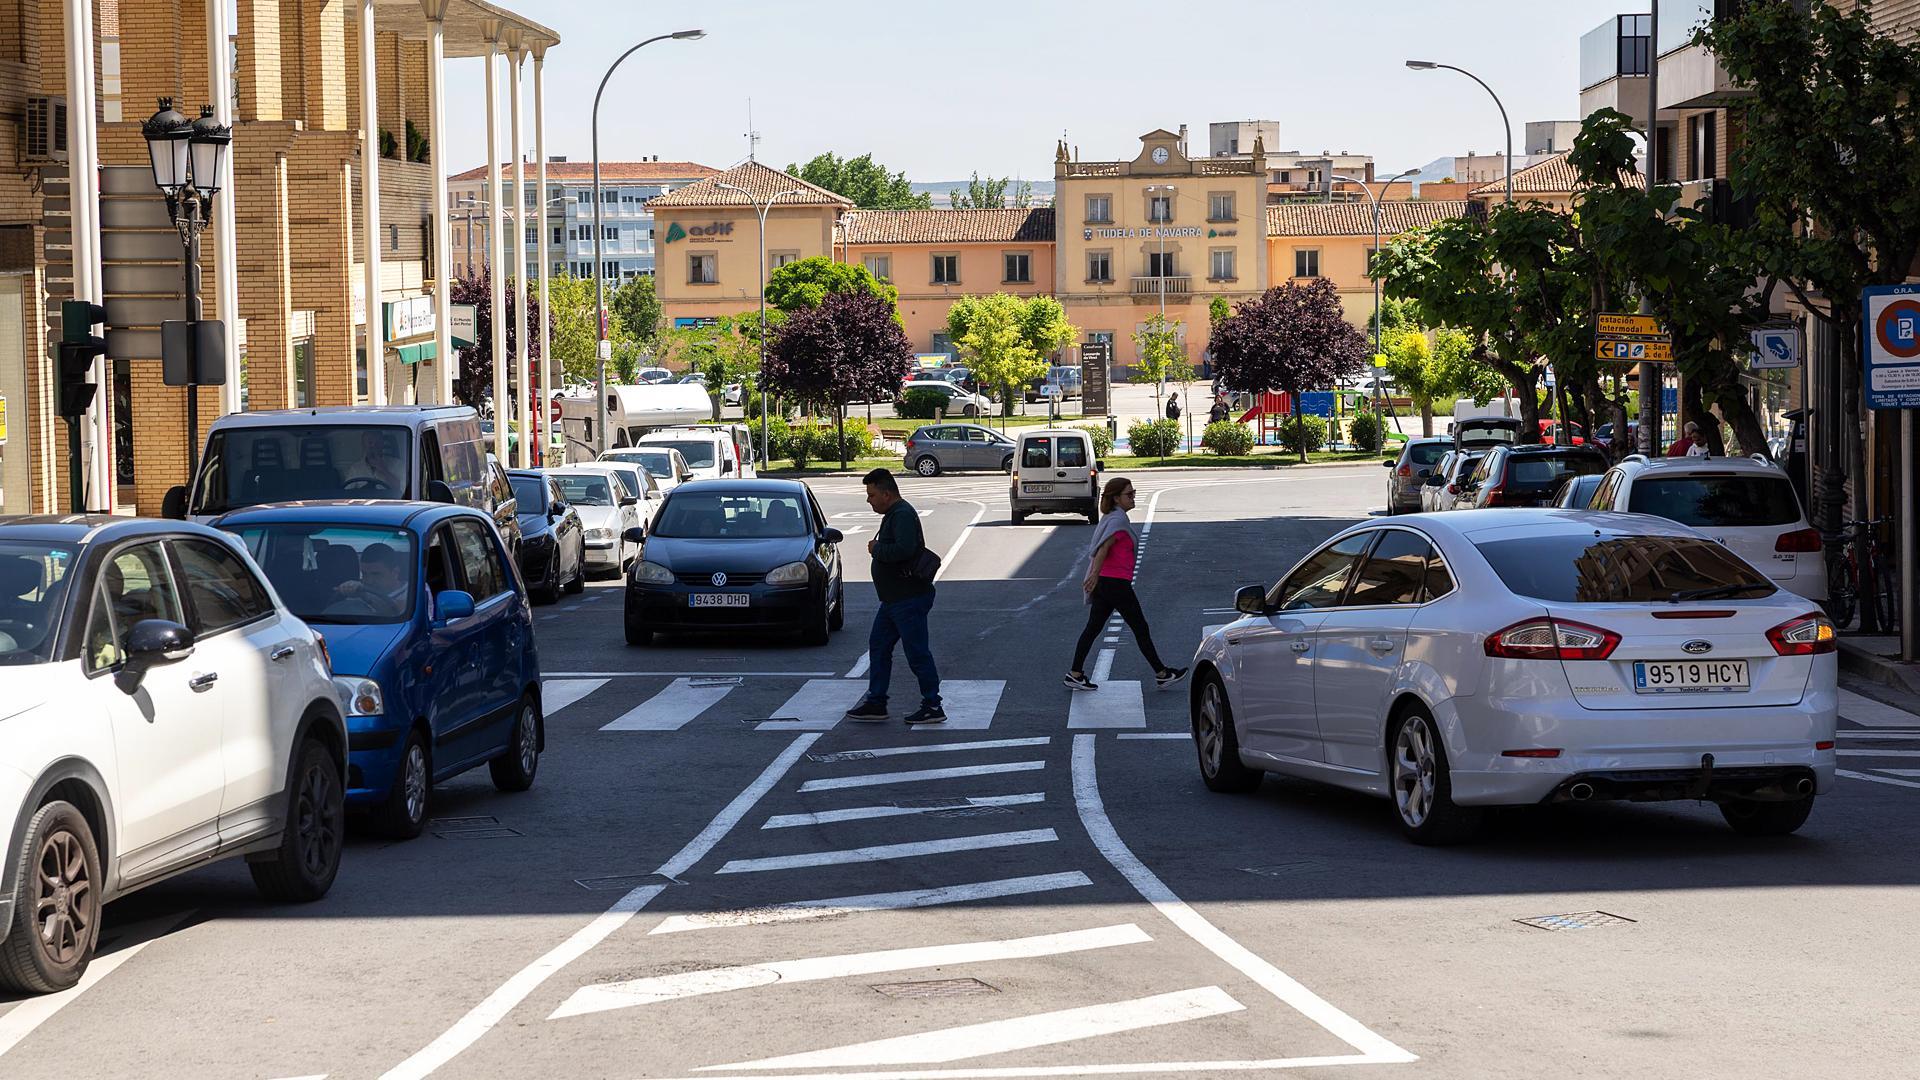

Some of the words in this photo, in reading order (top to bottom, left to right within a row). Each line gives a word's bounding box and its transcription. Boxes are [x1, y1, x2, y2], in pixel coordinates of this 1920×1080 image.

[689, 221, 735, 236] adif
[1097, 228, 1135, 239] TUDELA
[1139, 228, 1152, 238] DE
[1155, 227, 1203, 238] NAVARRA
[1600, 316, 1634, 325] estación
[1653, 343, 1667, 351] San
[696, 594, 723, 605] 9438
[727, 594, 747, 605] DHD
[1650, 664, 1700, 684] 9519
[1707, 663, 1743, 683] HCY
